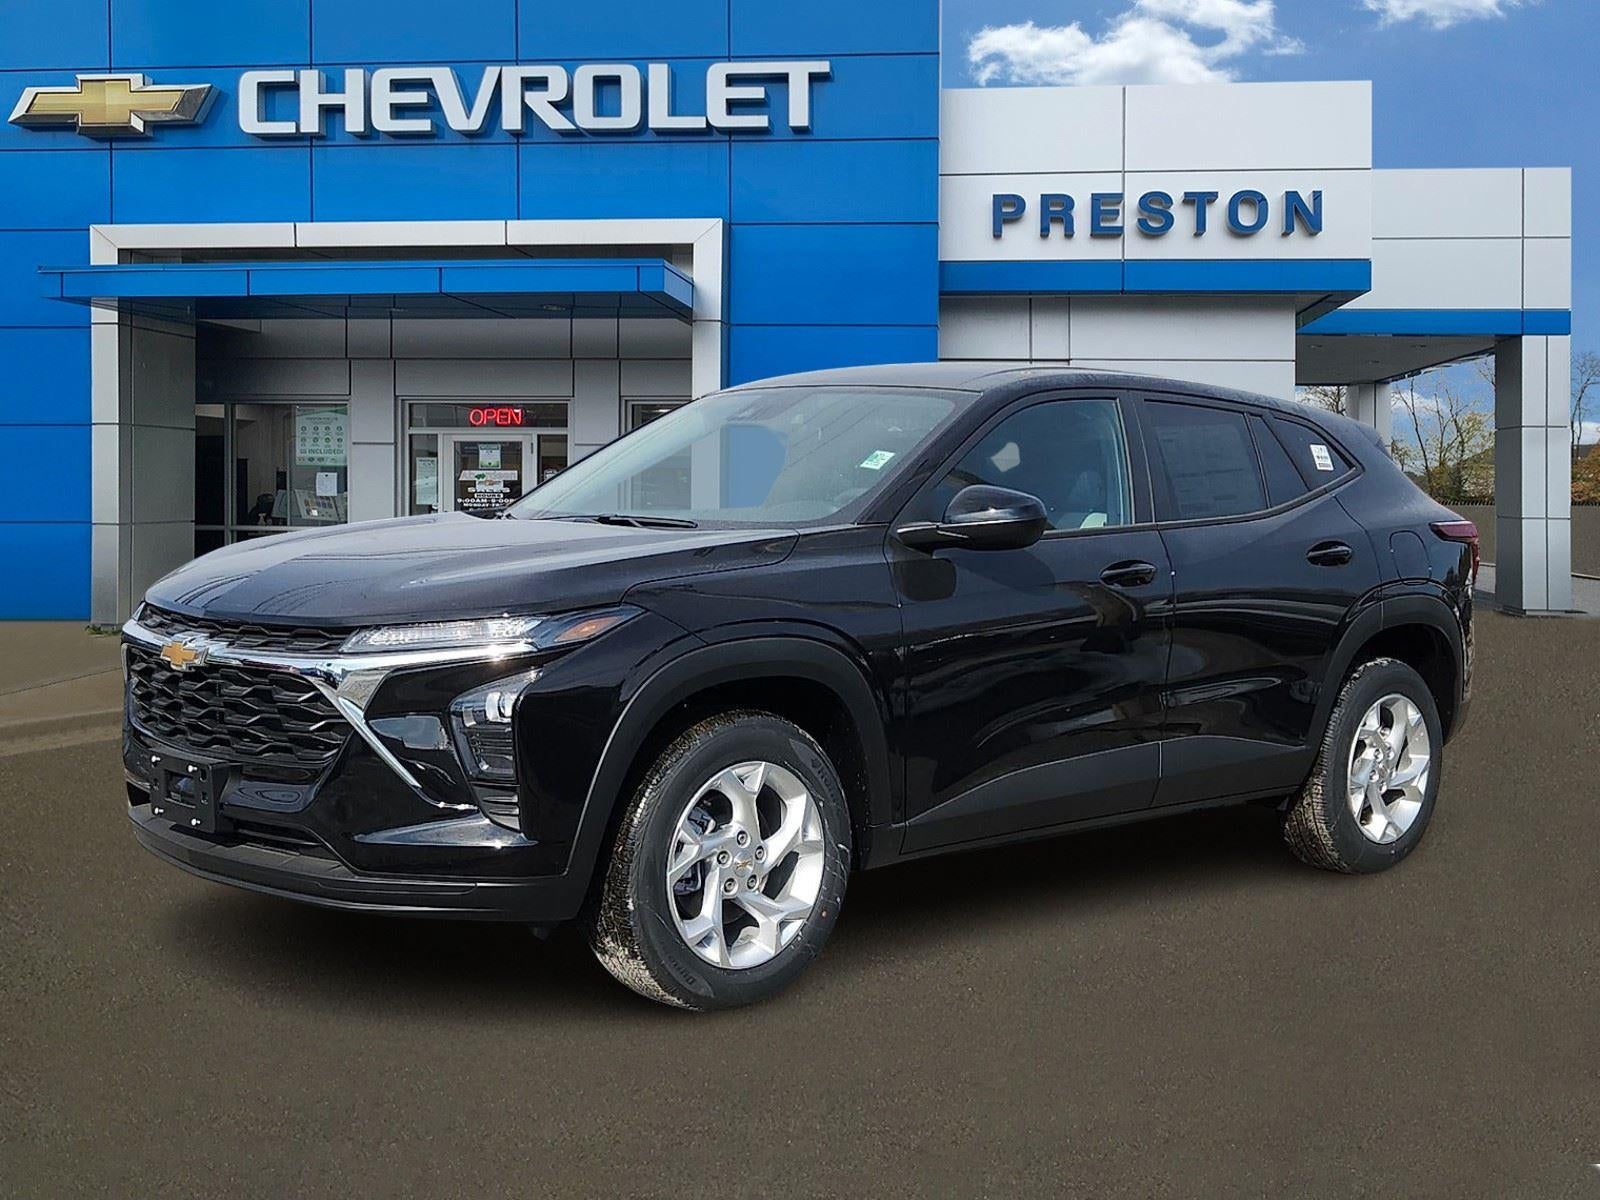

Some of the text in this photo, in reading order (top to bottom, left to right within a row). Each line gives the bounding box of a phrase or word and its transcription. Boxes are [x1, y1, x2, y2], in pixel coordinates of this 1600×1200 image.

[238, 60, 830, 137] CHEVROLET
[992, 189, 1323, 239] PRESTON
[470, 408, 522, 426] OPEN
